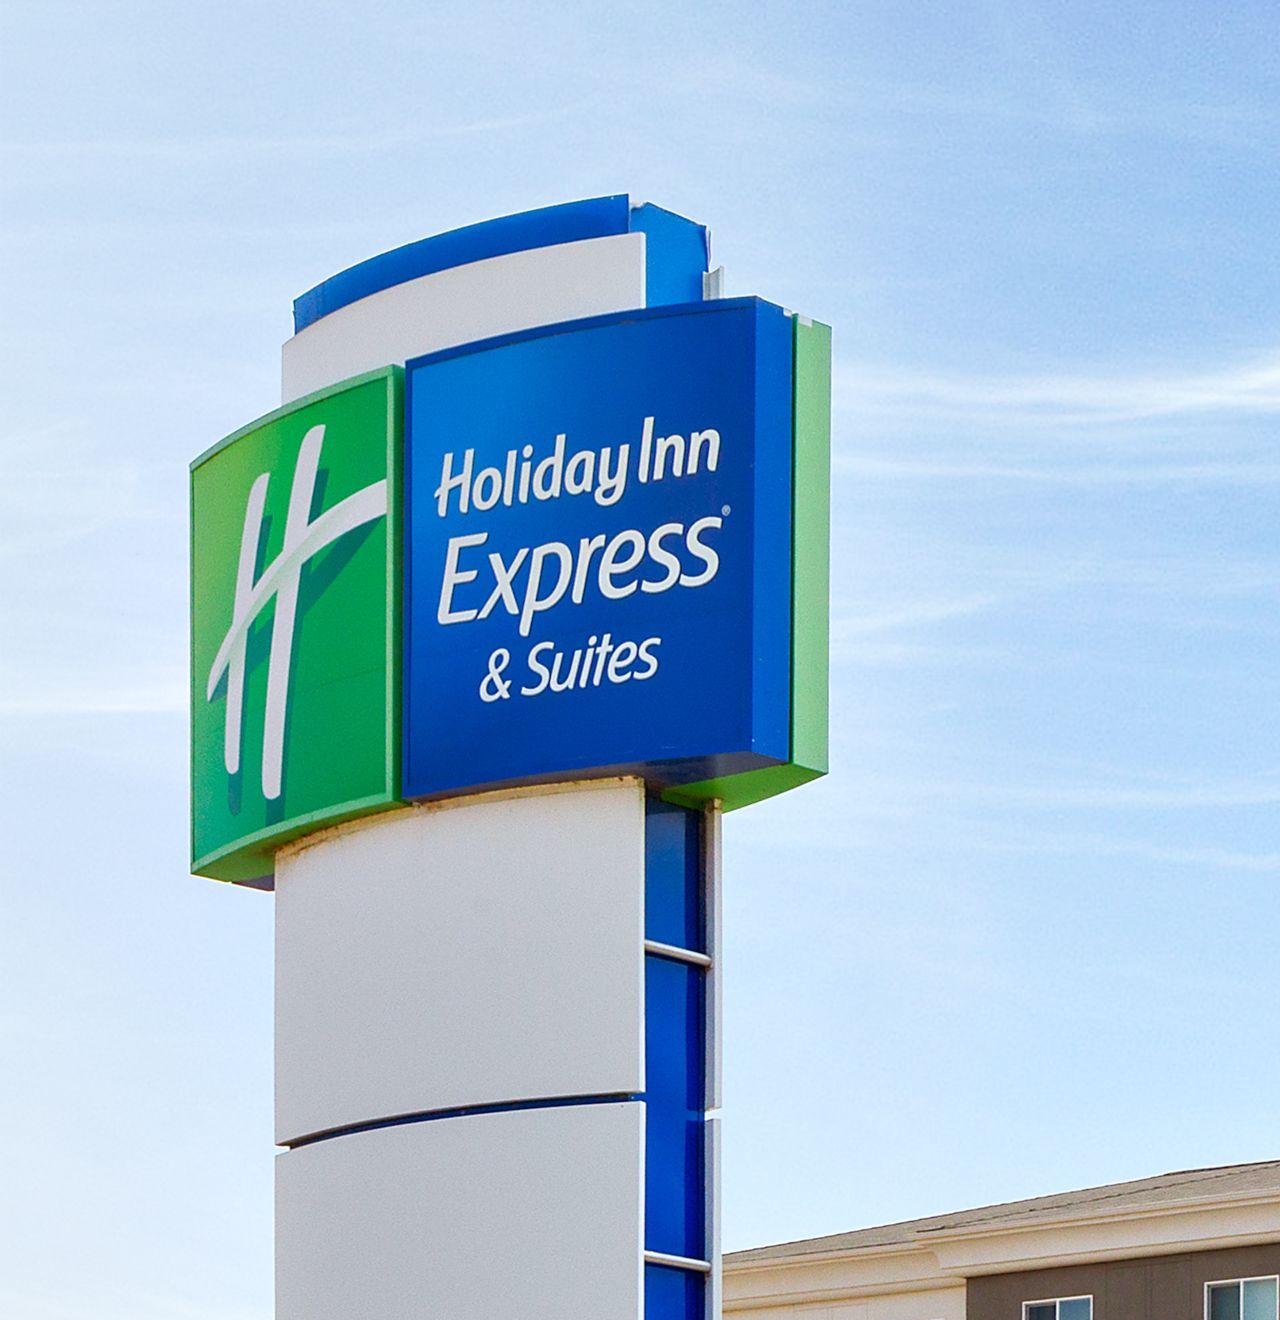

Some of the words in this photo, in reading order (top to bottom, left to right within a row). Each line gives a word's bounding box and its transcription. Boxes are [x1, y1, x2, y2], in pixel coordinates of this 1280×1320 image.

[434, 434, 630, 517] Holiday
[638, 416, 720, 483] Inn
[437, 516, 723, 637] Express
[479, 648, 512, 702] &
[521, 633, 662, 697] Suites
